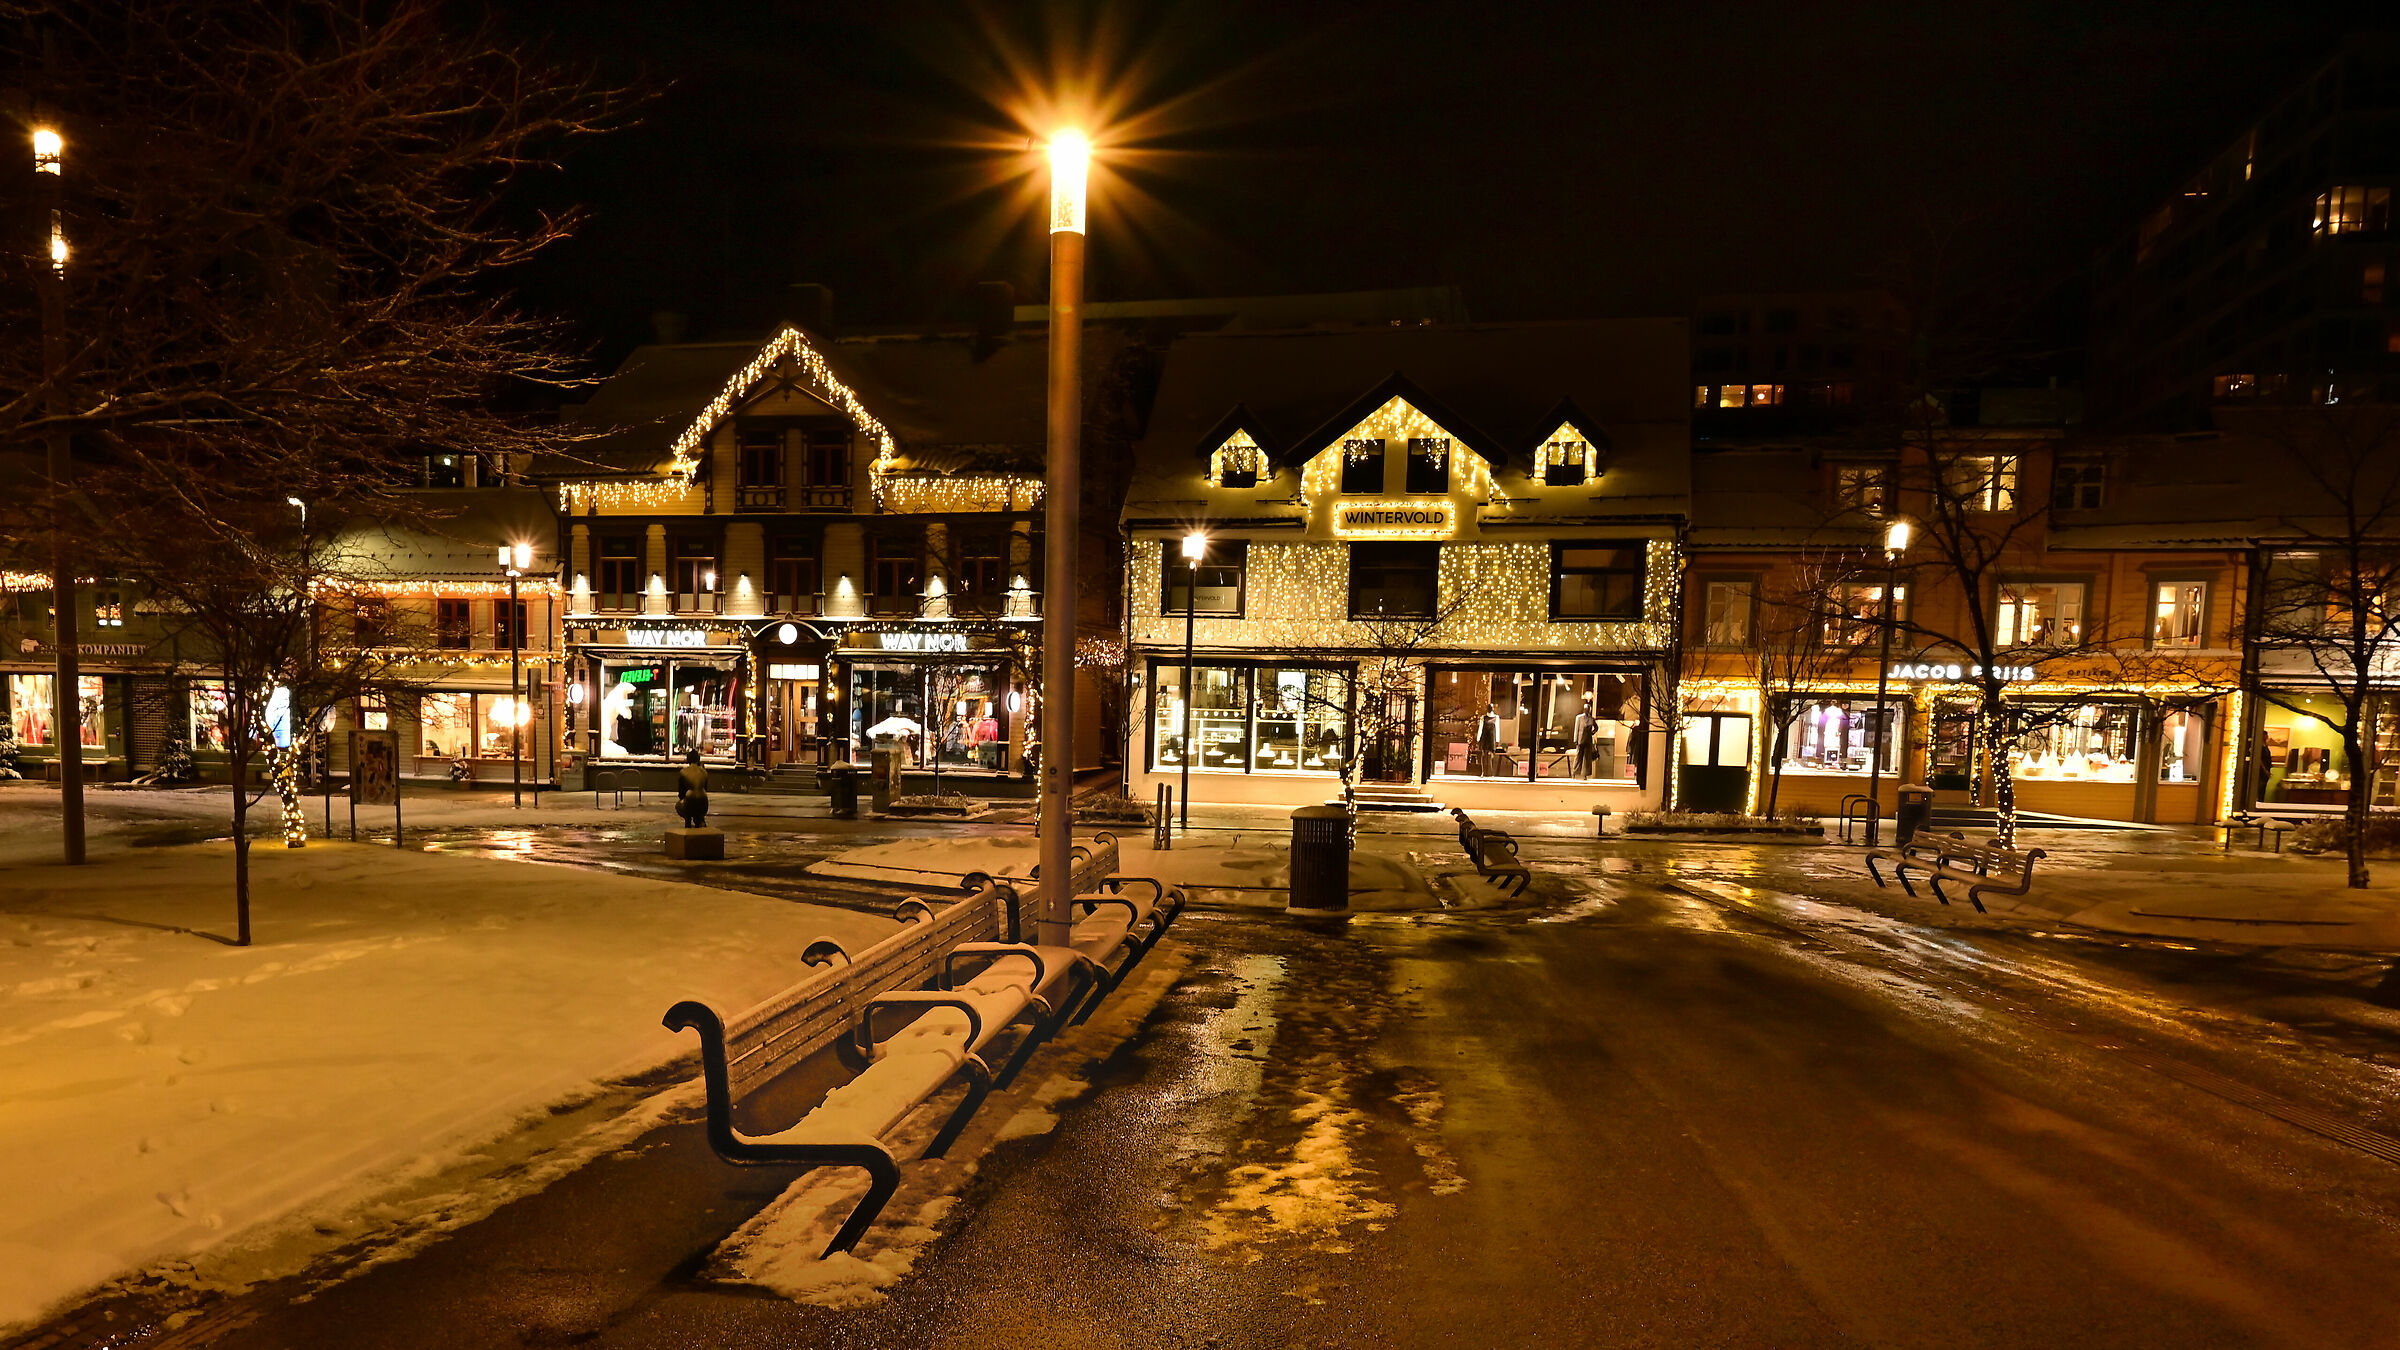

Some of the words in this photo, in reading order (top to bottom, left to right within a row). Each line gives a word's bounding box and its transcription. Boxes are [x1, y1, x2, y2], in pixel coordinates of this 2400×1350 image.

[1344, 511, 1444, 524] WINTERVOLD
[626, 629, 665, 646] WAY
[666, 630, 707, 647] NOR
[880, 632, 923, 651] WAY
[924, 633, 968, 652] NOR
[78, 643, 146, 656] KOMPANIET
[1887, 664, 1962, 680] JACOB
[1971, 665, 2035, 681] FRIIS
